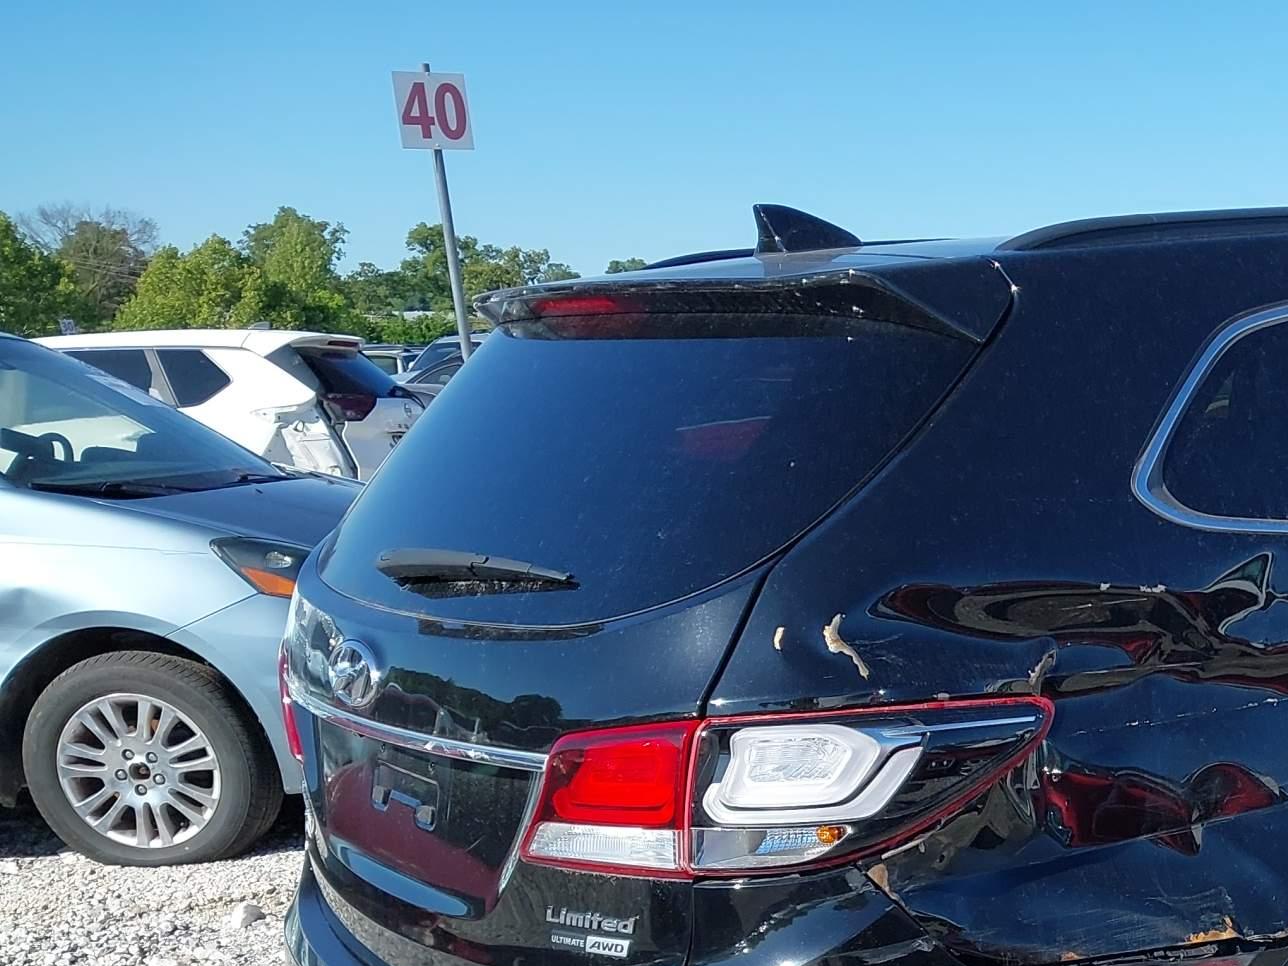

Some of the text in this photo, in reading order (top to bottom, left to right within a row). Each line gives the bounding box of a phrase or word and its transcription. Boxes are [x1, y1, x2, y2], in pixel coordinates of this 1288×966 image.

[402, 82, 466, 140] 40
[545, 905, 639, 935] Limited
[551, 934, 625, 954] ULTIMATE AWD
